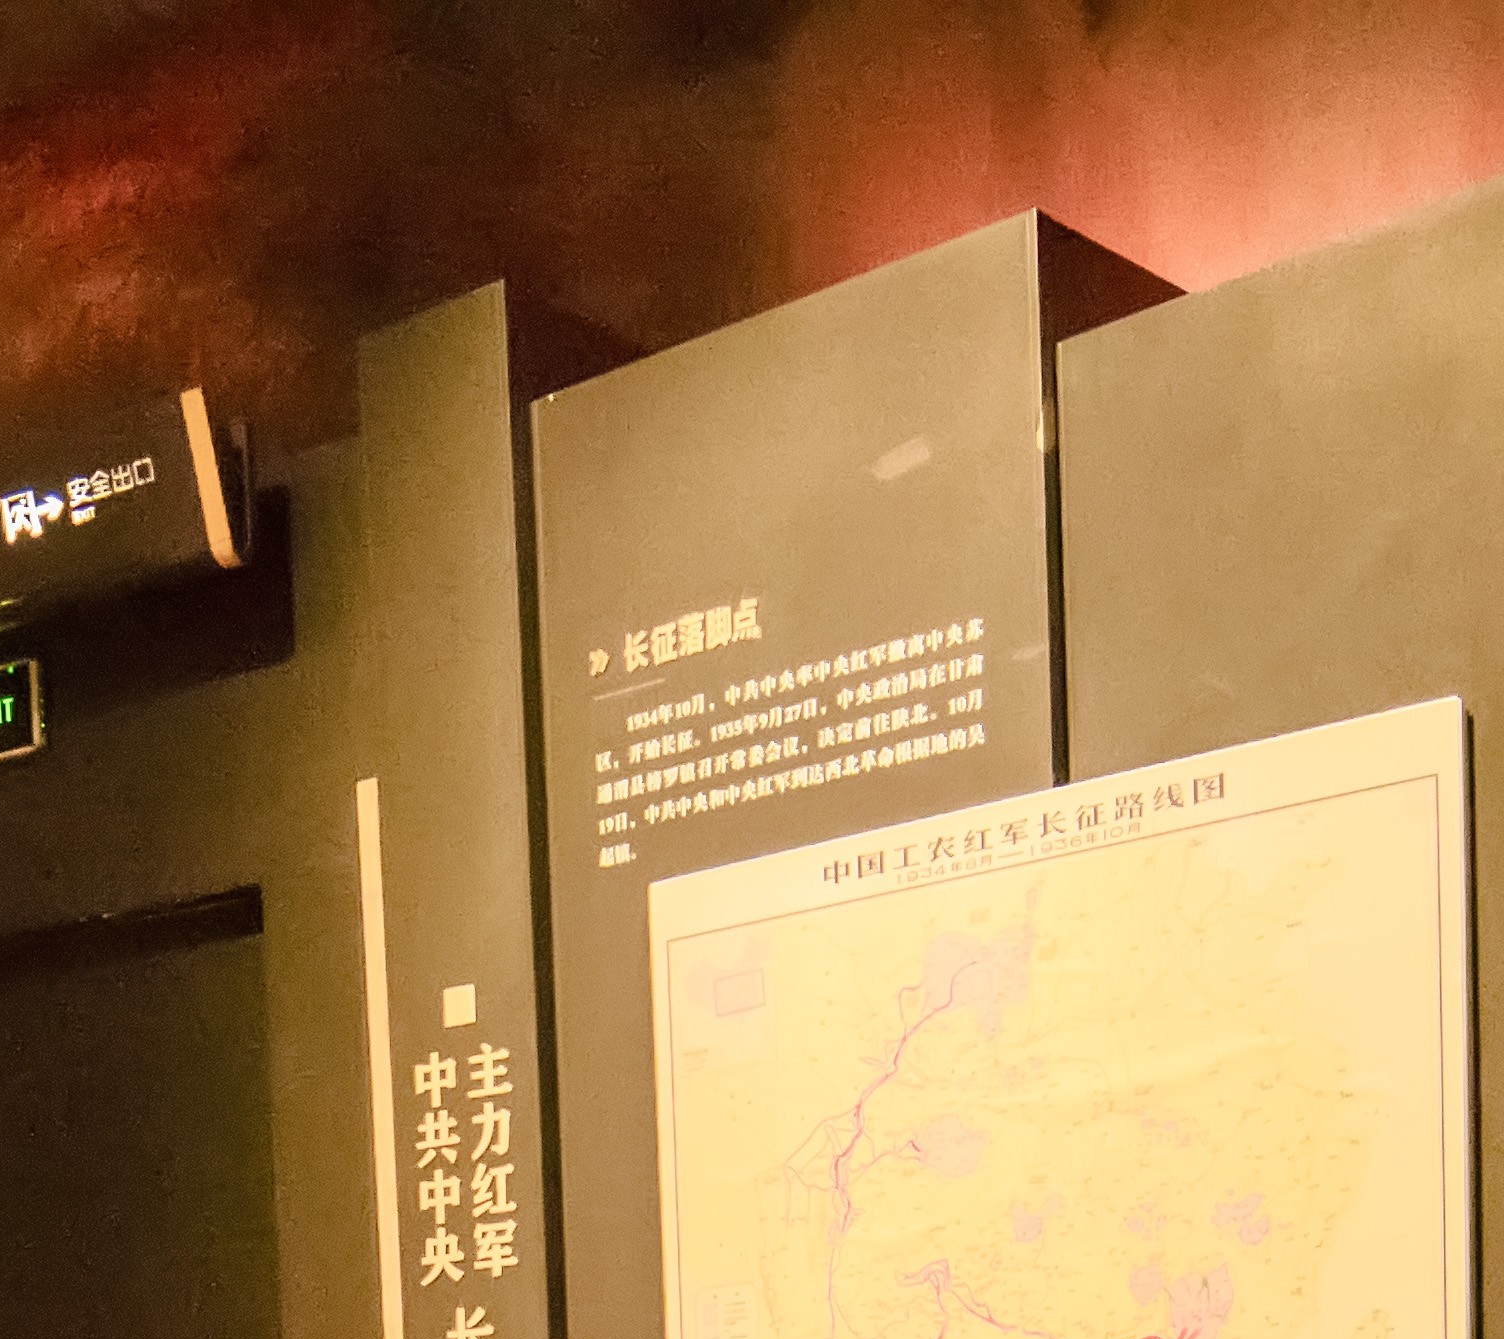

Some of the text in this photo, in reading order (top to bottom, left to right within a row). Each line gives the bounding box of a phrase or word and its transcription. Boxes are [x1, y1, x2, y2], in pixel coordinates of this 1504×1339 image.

[66, 456, 156, 506] 安全出口
[624, 597, 763, 674] 长征落脚点
[823, 772, 1226, 886] 中国工农红军长征路线图
[414, 1051, 466, 1287] 中共中央
[466, 1042, 520, 1279] 主力红军
